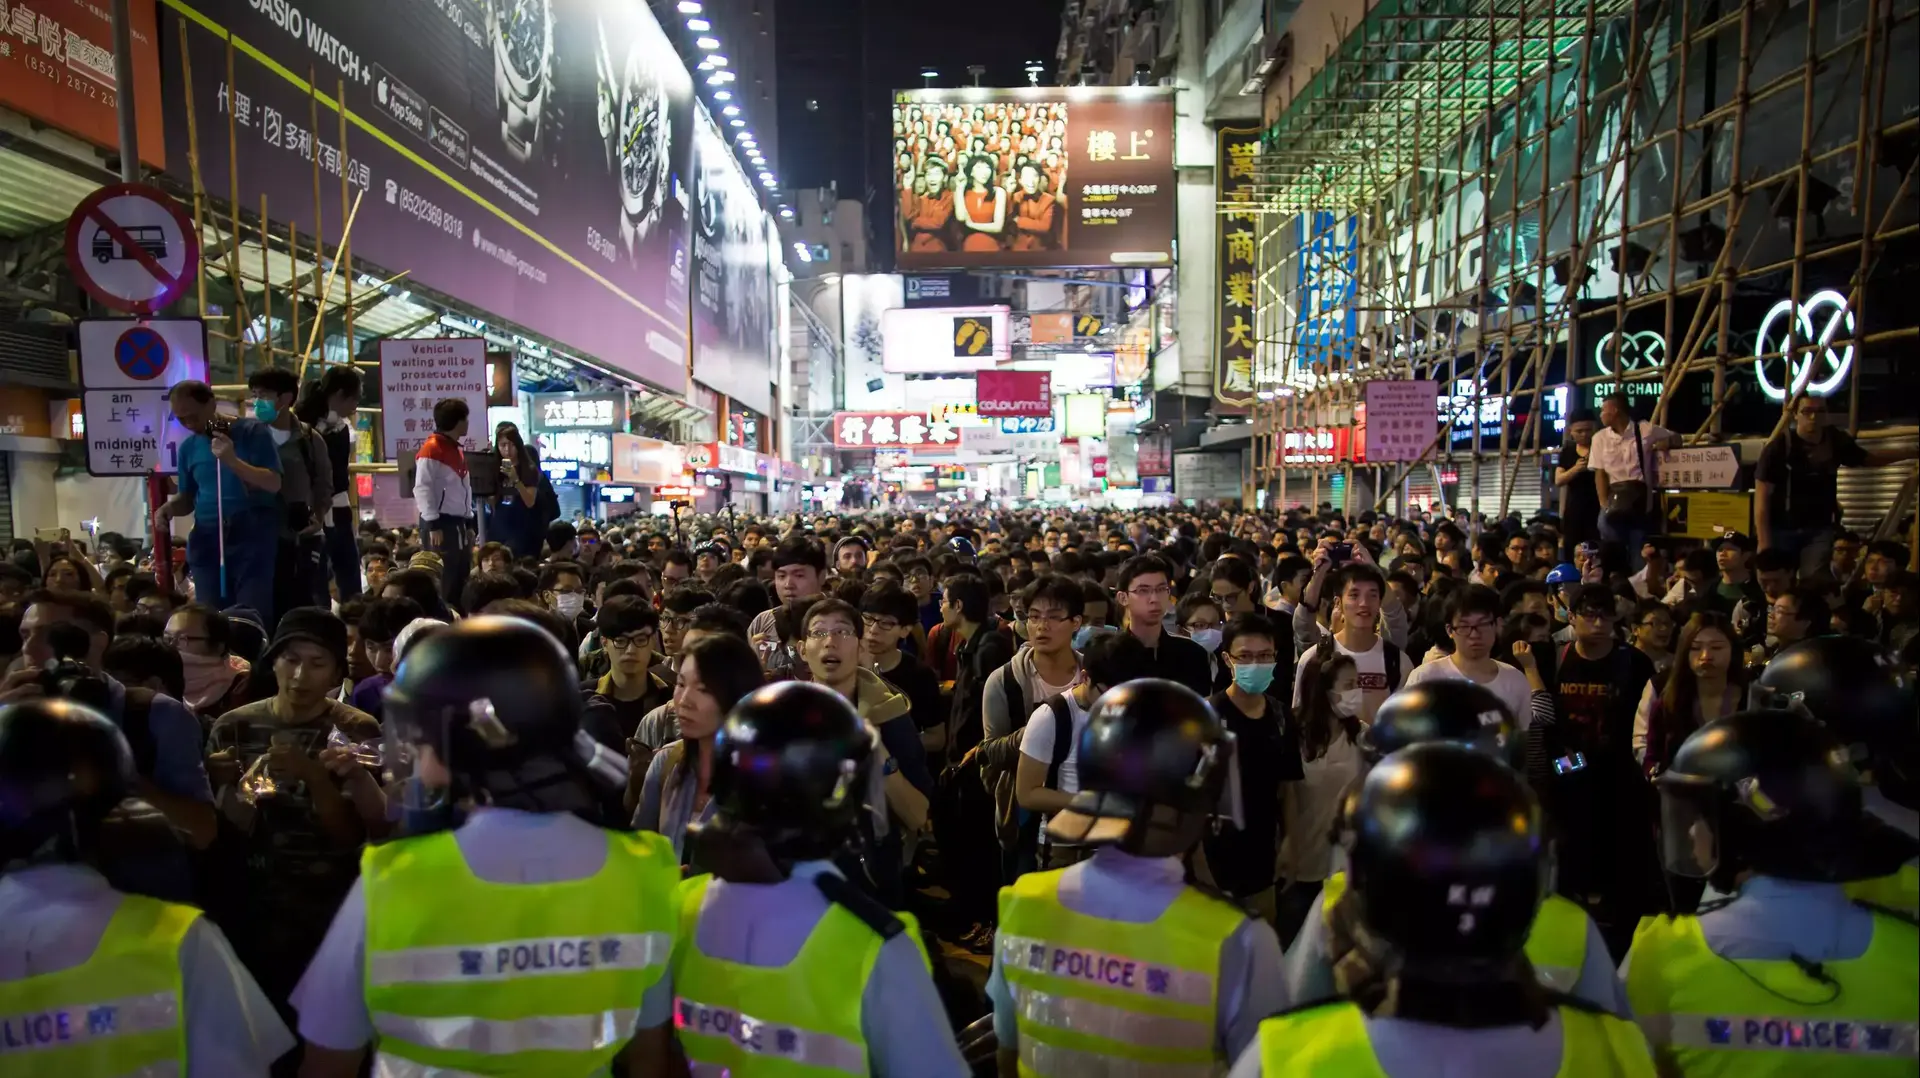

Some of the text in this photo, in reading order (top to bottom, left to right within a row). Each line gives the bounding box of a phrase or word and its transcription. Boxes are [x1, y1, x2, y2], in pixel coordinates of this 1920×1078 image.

[248, 0, 303, 39] ASIO
[306, 17, 360, 81] WATCH
[25, 53, 60, 83] (852)
[67, 74, 96, 98] 2872
[1086, 130, 1150, 161] 樓上
[411, 344, 454, 354] Vehicle
[392, 355, 475, 368] waiting will be
[401, 369, 466, 381] prosecuted
[387, 382, 482, 392] without warning
[1594, 382, 1624, 396] CIT
[112, 394, 133, 404] am
[979, 399, 1050, 411] colourmix
[107, 408, 141, 422] 上午
[404, 418, 435, 432] 會被
[94, 438, 157, 451] midnight
[166, 441, 178, 467] 1
[1681, 452, 1704, 463] Street
[1706, 450, 1728, 462] South
[110, 454, 144, 469] 午夜
[1560, 682, 1587, 696] NOT
[497, 940, 592, 973] POLICE
[1052, 948, 1136, 988] POLICE
[4, 1011, 71, 1048] LICE
[1744, 1019, 1850, 1049] POLICE
